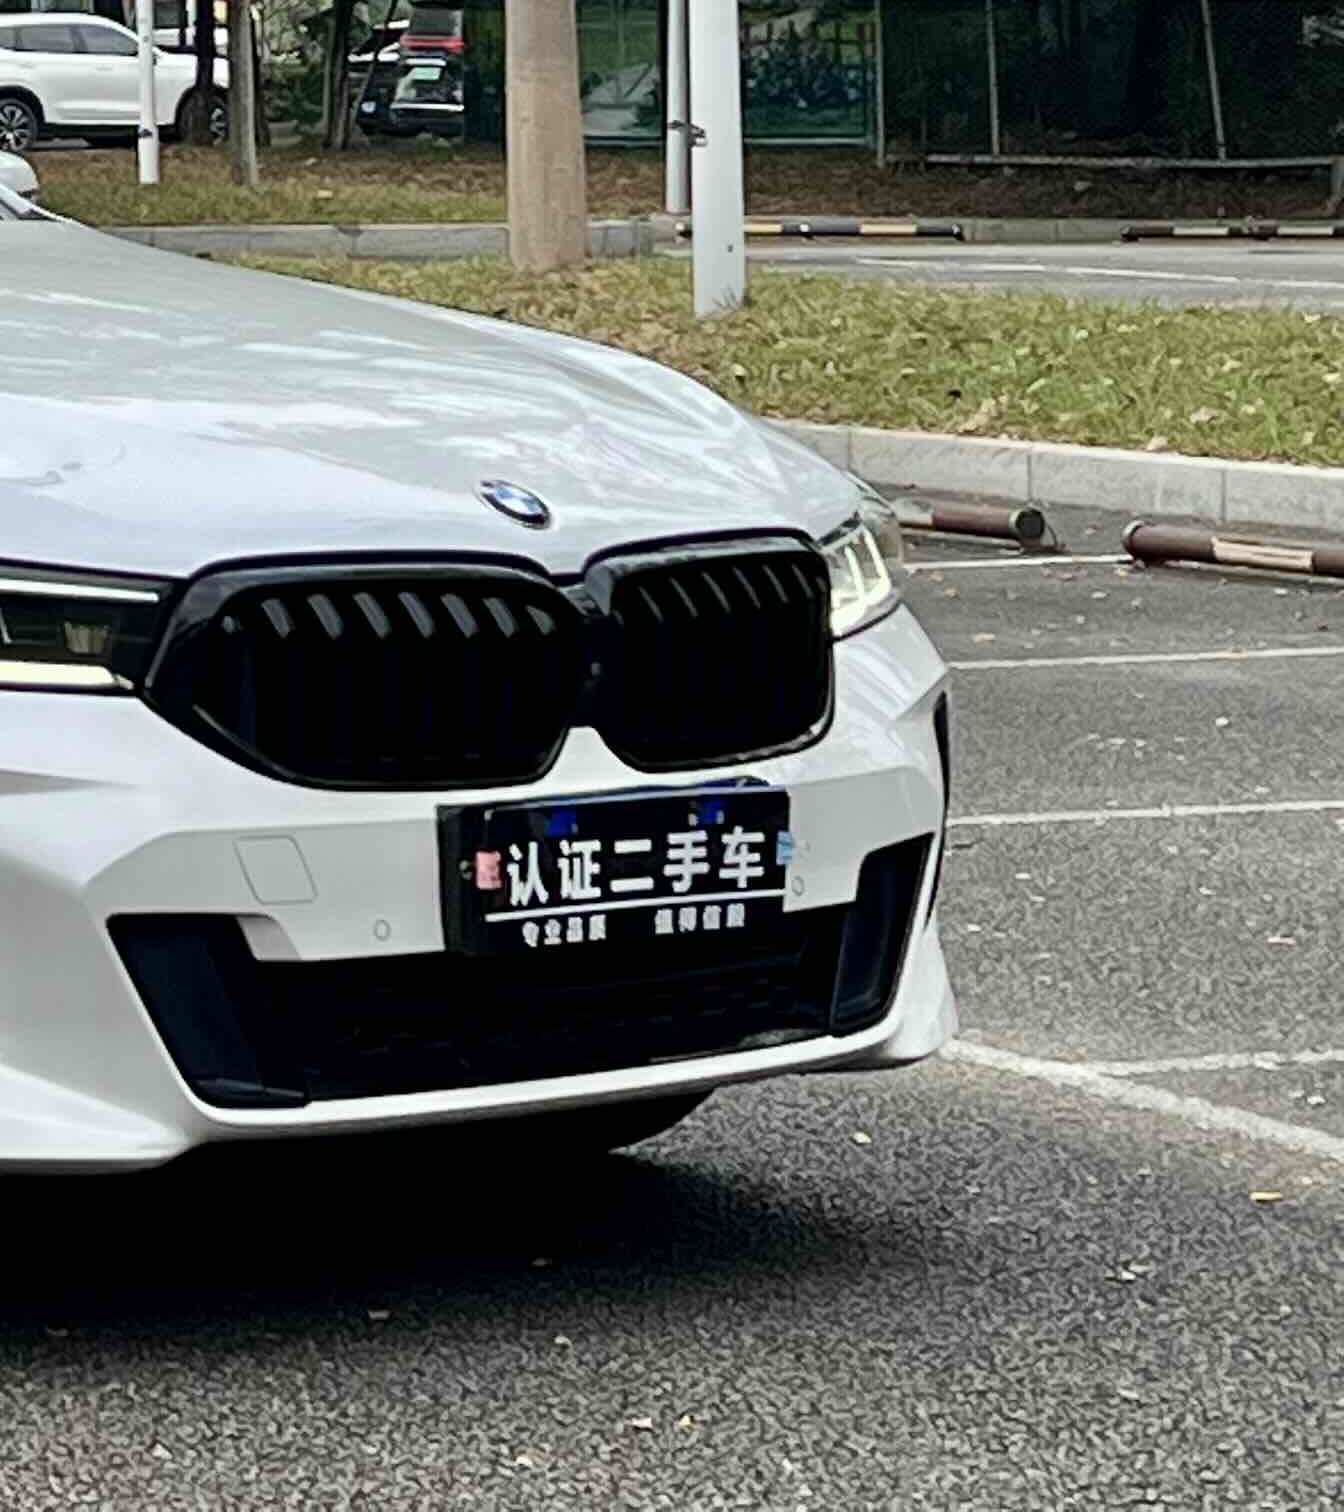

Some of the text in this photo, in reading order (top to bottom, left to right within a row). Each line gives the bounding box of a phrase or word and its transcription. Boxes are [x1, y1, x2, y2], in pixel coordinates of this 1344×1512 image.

[506, 825, 766, 907] 认证二手车
